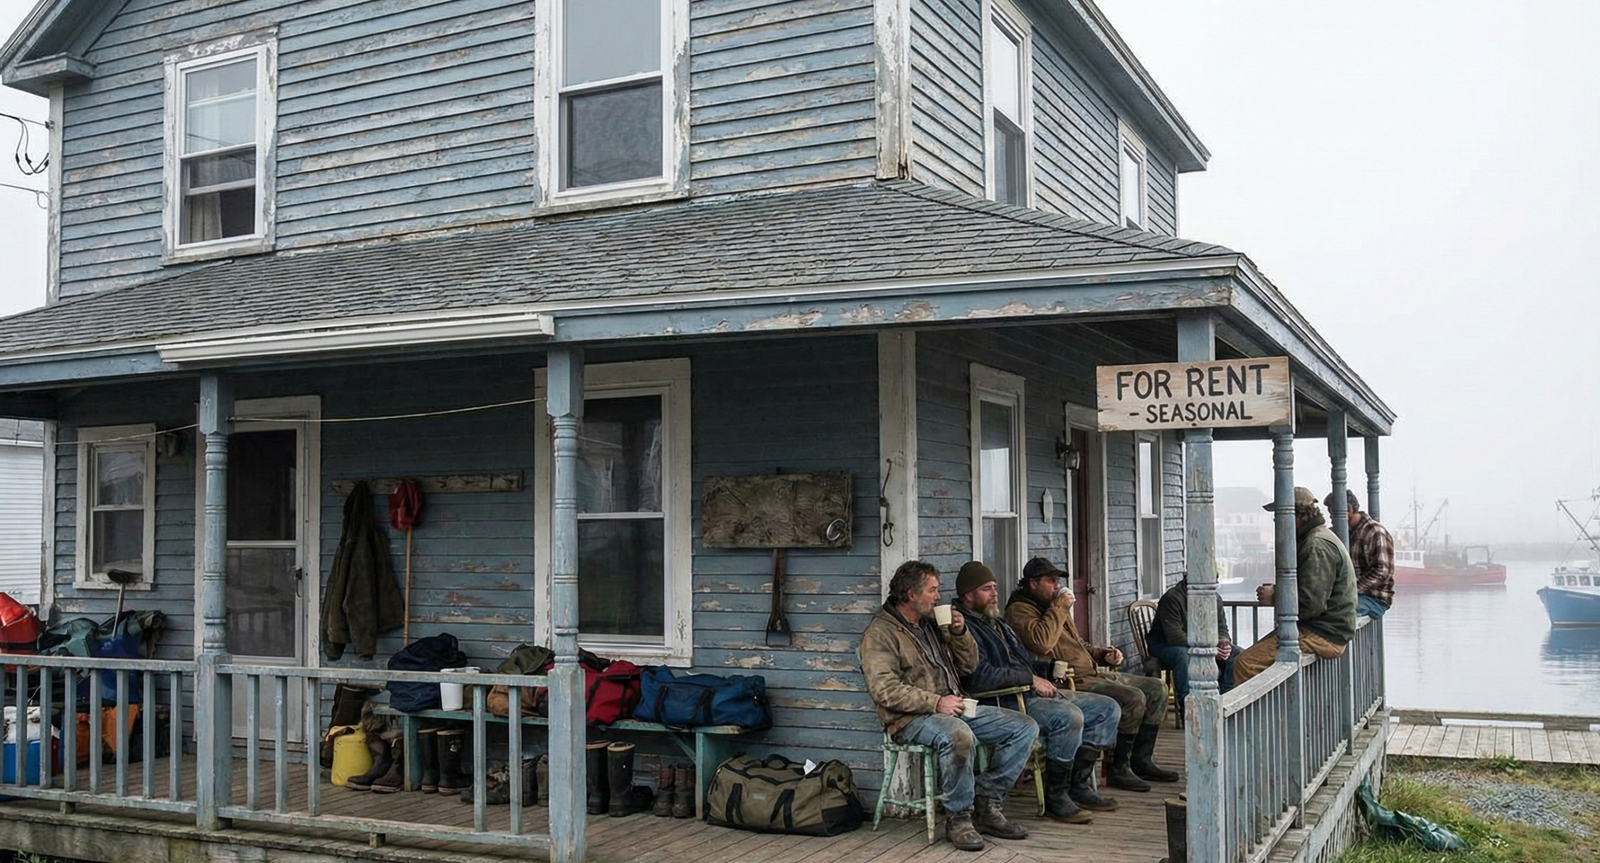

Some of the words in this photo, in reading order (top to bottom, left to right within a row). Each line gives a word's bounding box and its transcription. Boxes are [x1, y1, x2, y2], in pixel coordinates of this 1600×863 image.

[1116, 369, 1172, 401] FOR
[1185, 363, 1270, 398] RENT
[1146, 401, 1253, 424] SEASONAL
